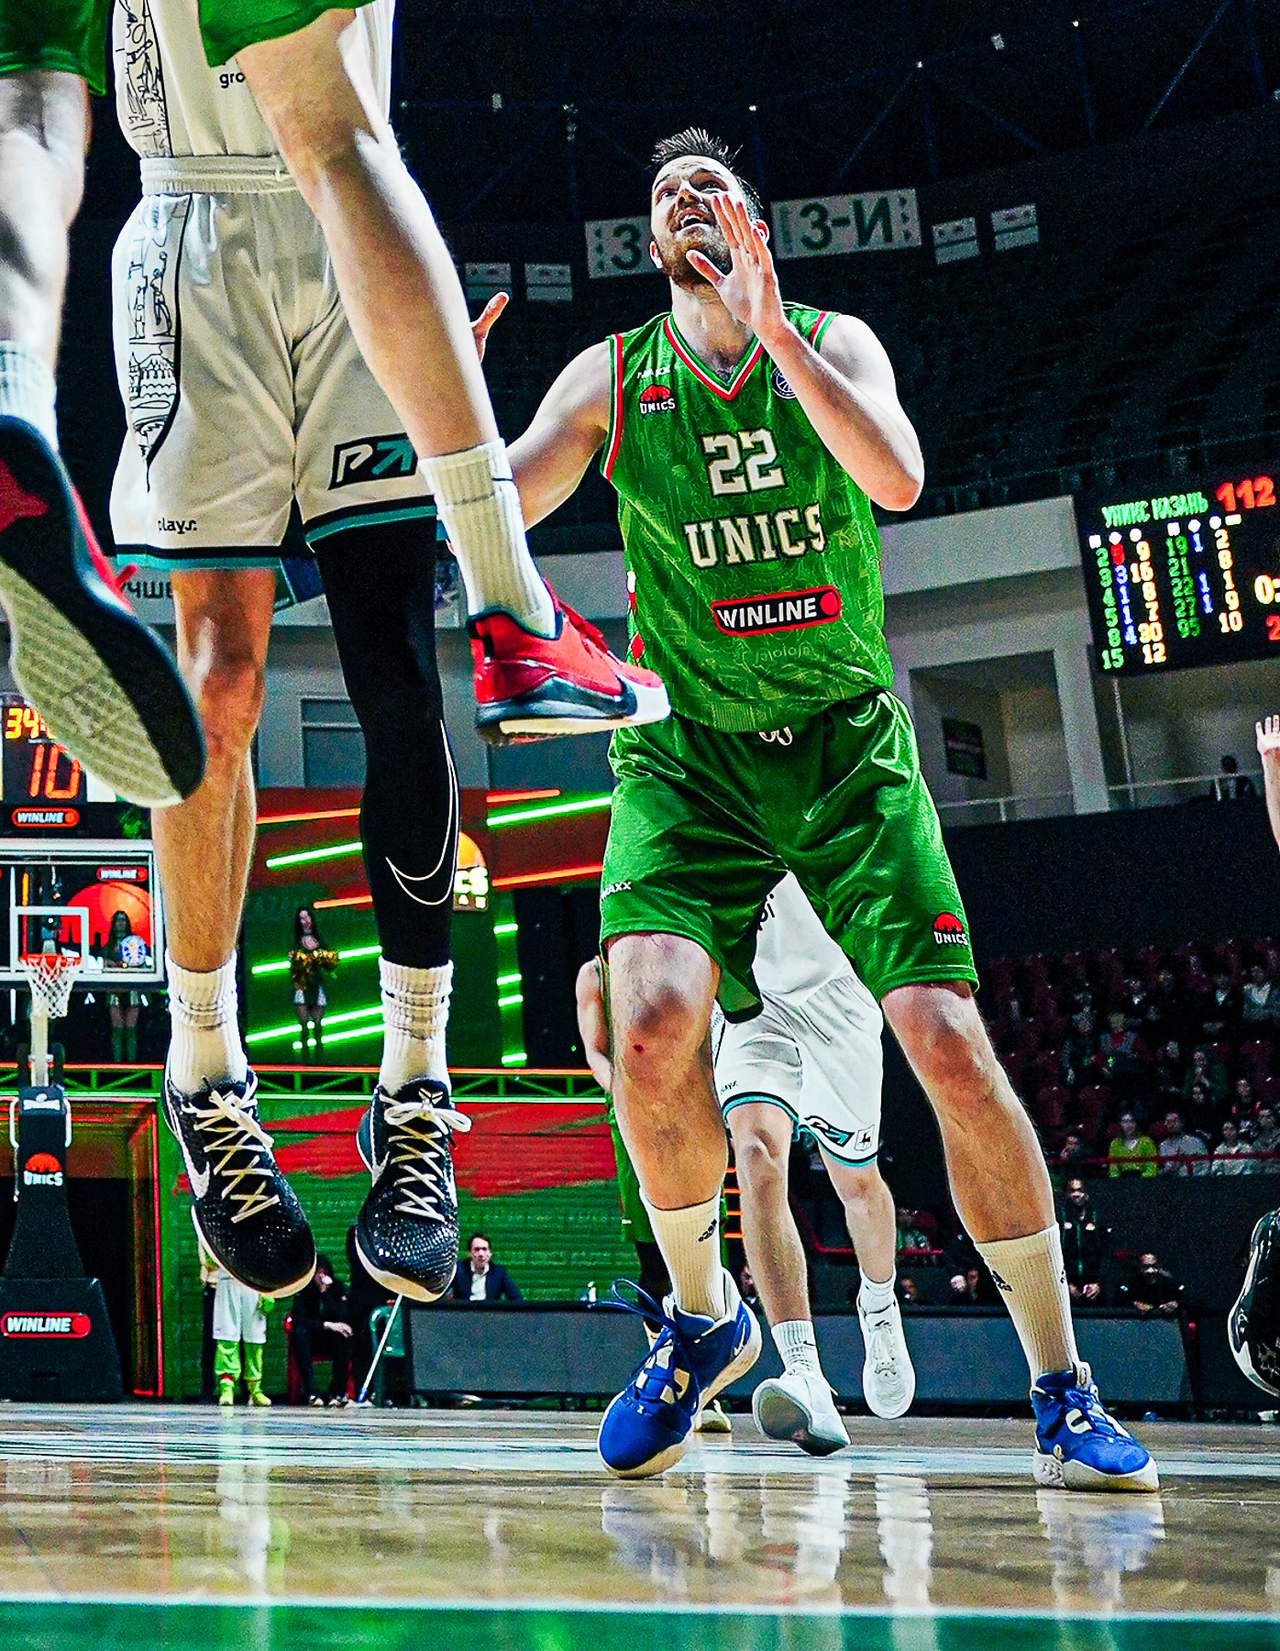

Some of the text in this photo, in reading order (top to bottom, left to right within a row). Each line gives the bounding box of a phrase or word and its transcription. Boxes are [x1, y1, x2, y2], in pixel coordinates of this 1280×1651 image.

[219, 72, 247, 89] gro
[639, 397, 676, 415] UNICS
[700, 427, 787, 497] 22
[1216, 476, 1277, 512] 112
[682, 503, 827, 569] UNICS
[1095, 547, 1110, 568] 2
[1136, 540, 1151, 562] 9
[1165, 535, 1189, 557] 19
[1192, 532, 1204, 553] 1
[1214, 528, 1230, 550] 2
[1099, 567, 1113, 588] 3
[1168, 557, 1190, 577] 21
[1217, 549, 1233, 570] 8
[1102, 570, 1235, 607] 4 1 8 22 1 1
[715, 596, 818, 629] WINLINE
[1104, 590, 1240, 628] 5 1 7 27 1 9
[1176, 616, 1201, 639] 95
[1218, 610, 1243, 634] 10
[1101, 642, 1167, 670] 15 12
[29, 742, 82, 800] 10
[16, 812, 65, 824] WINLINE
[933, 931, 969, 946] UNICS
[23, 1170, 64, 1187] UNICS
[7, 1316, 73, 1334] WINLINE
